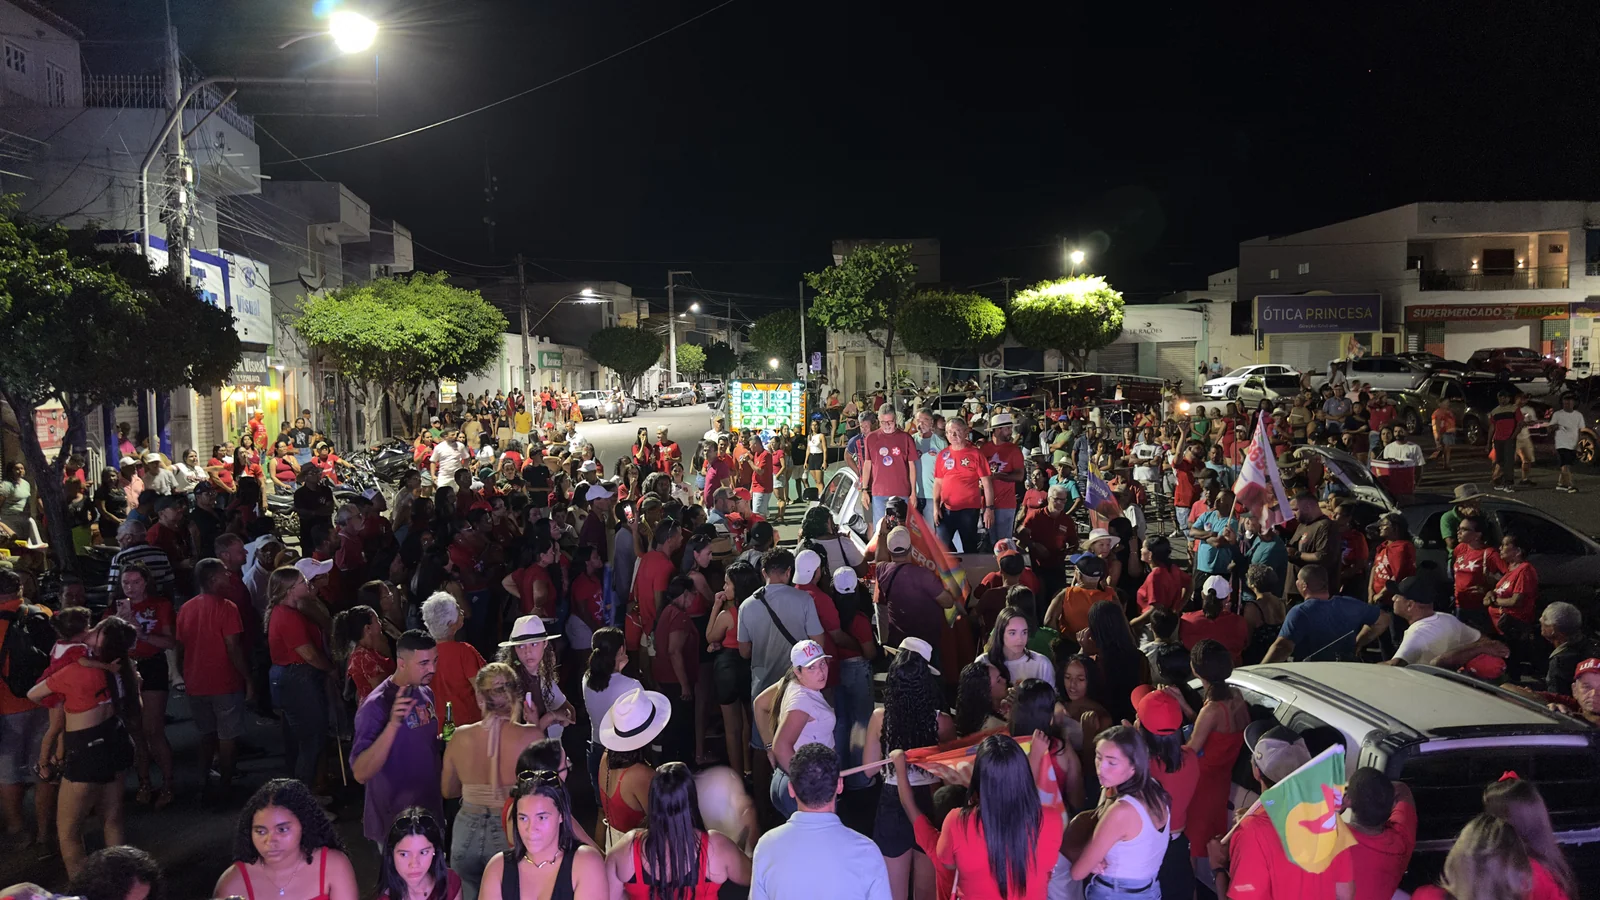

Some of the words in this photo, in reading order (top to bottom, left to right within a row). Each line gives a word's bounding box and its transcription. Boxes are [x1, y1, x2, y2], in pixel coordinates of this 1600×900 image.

[236, 295, 260, 316] Visual
[1413, 307, 1502, 317] SUPERMERCADO
[1518, 306, 1565, 316] MACEDO
[1263, 306, 1303, 320] ÓTICA
[1306, 307, 1373, 319] PRINCESA
[243, 357, 267, 373] Visual
[803, 644, 820, 658] 12+1
